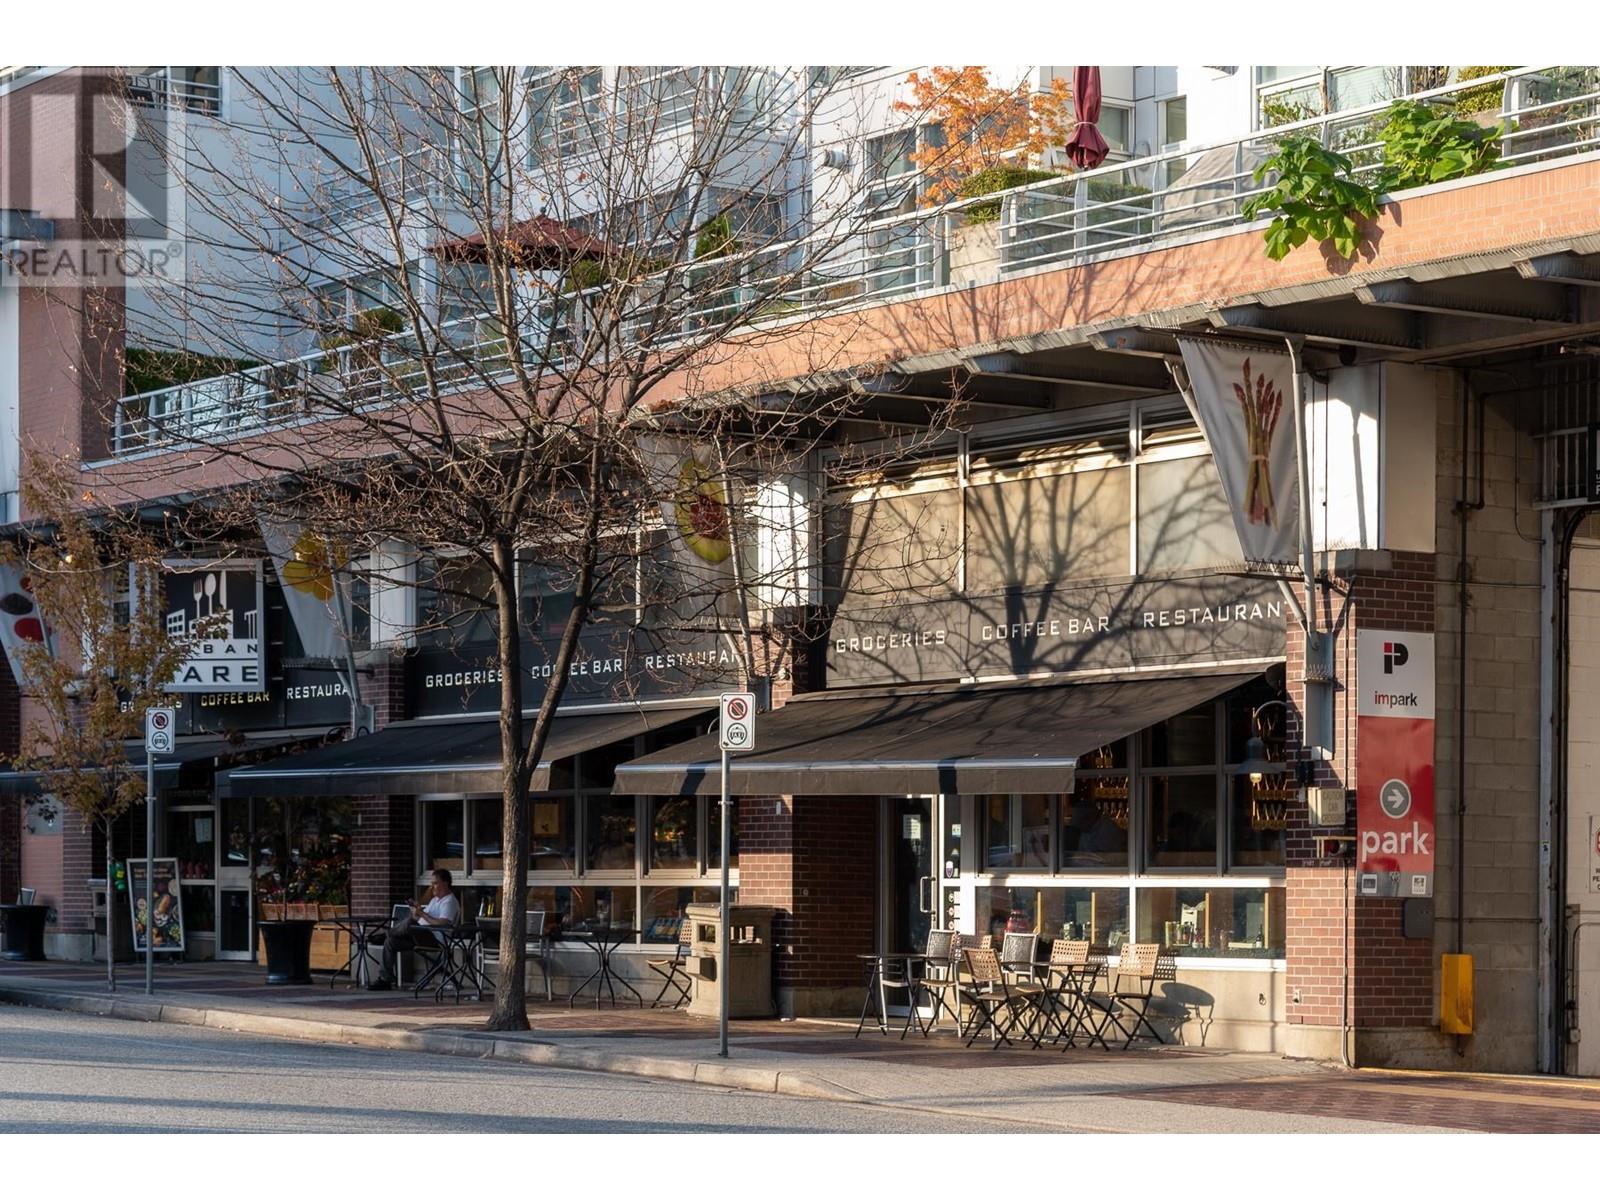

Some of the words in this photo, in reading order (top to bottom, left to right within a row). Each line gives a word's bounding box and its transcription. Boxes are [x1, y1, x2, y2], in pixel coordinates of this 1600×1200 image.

[835, 628, 946, 653] GROCERIES
[982, 618, 1061, 641] COFFEE
[1068, 615, 1111, 635] BAR
[1143, 601, 1288, 628] RESTAURAN
[531, 661, 588, 680] COEE
[593, 658, 623, 674] BAR
[645, 649, 739, 669] RESTAURA
[200, 692, 244, 707] COFFEE
[247, 690, 271, 704] BAR
[1374, 690, 1418, 708] impark
[1361, 821, 1430, 863] park
